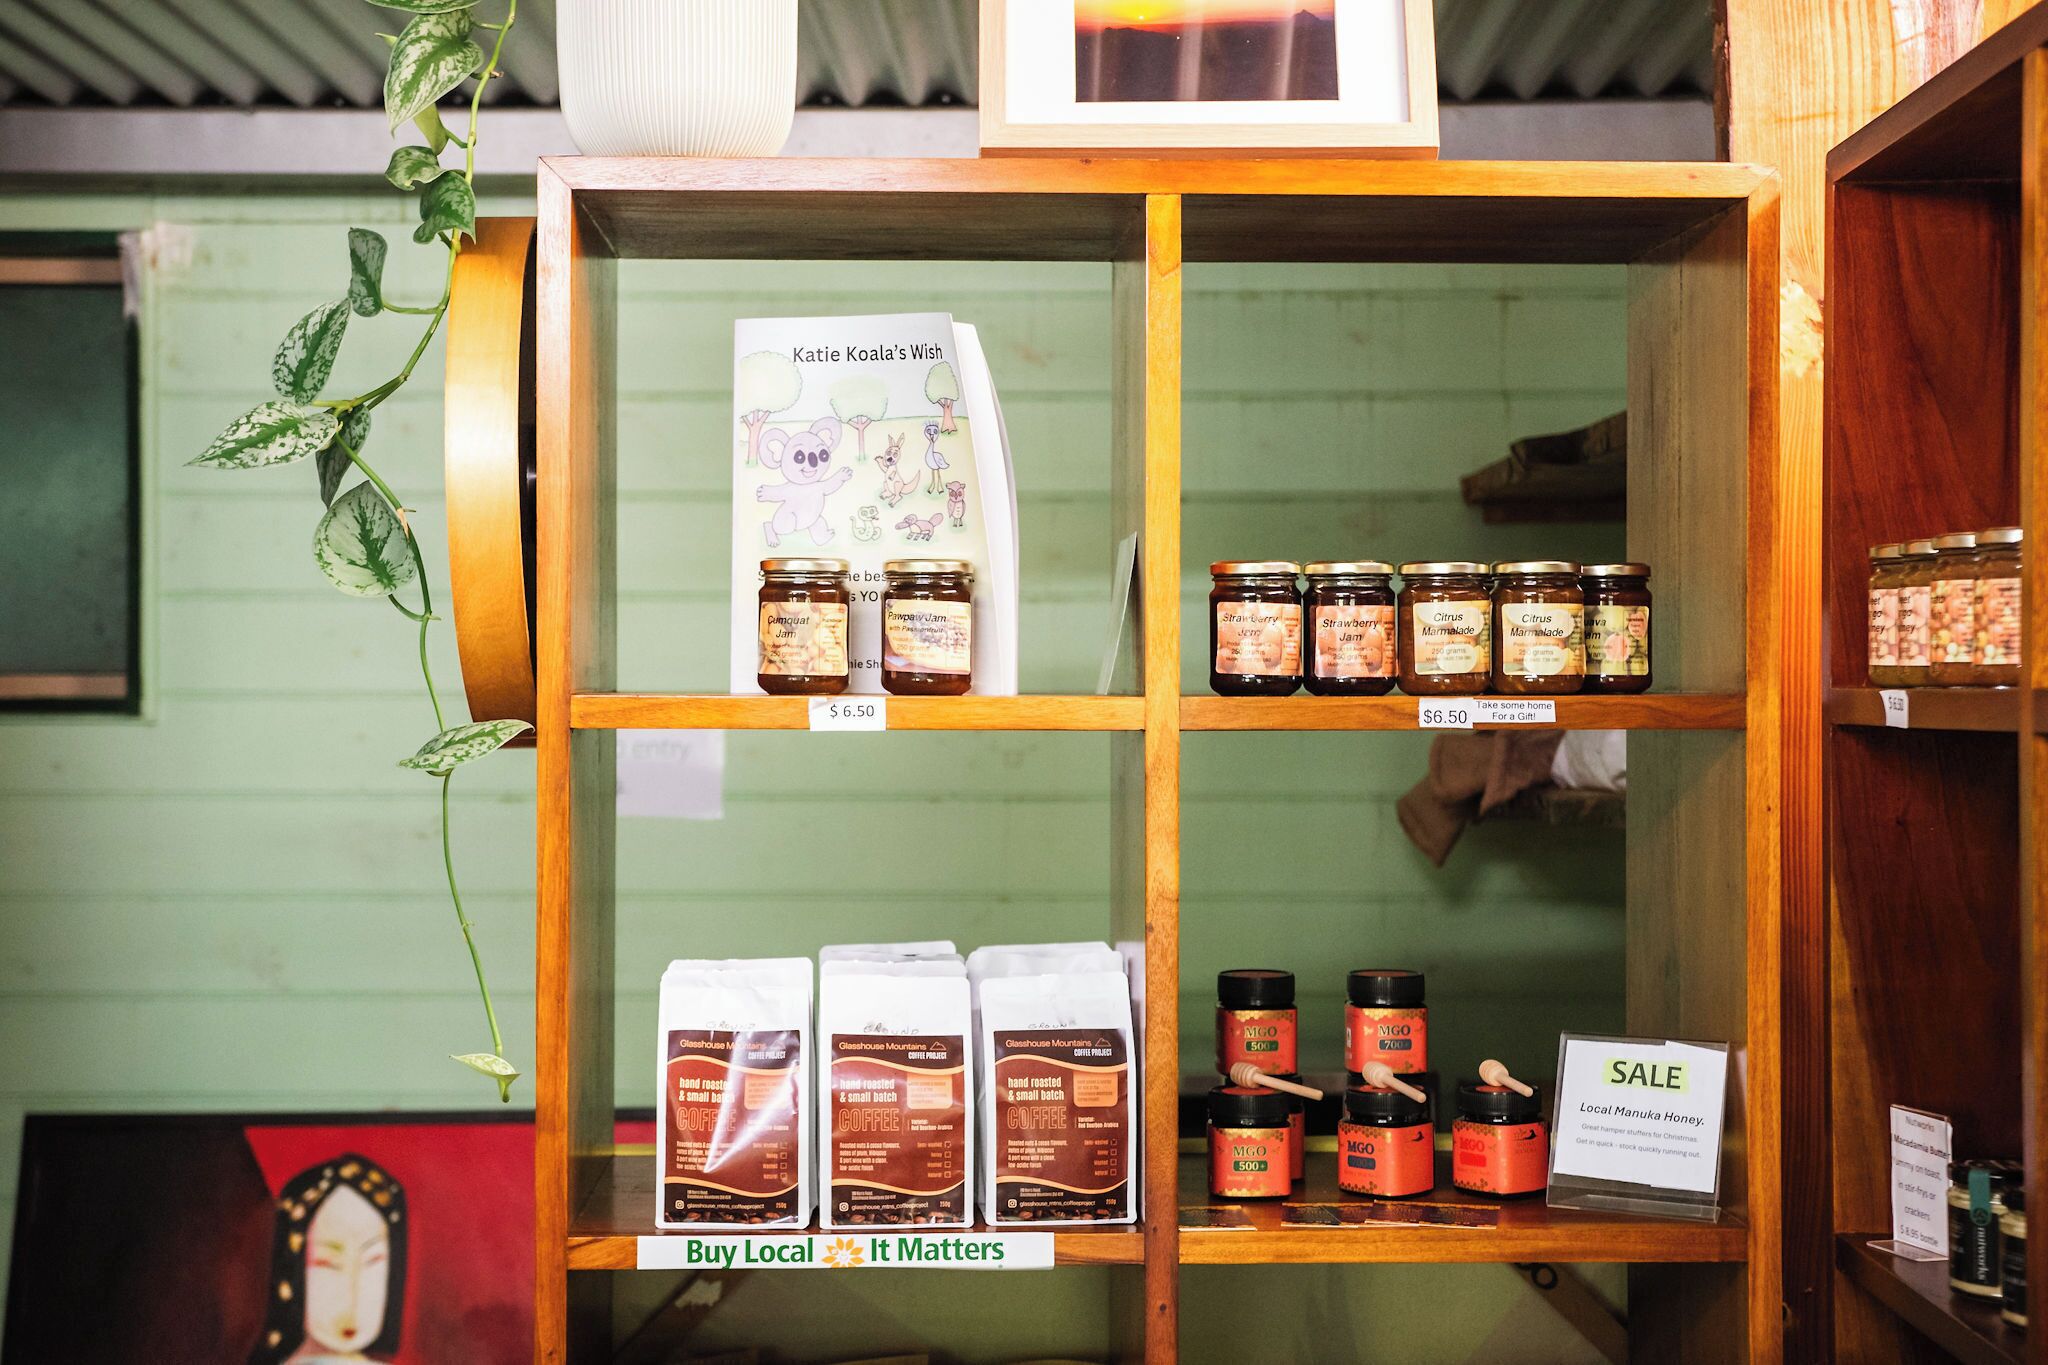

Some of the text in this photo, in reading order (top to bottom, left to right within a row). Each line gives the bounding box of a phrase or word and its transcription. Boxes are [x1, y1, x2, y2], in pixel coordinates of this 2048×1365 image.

[793, 343, 944, 363] Katie Koala's Wish
[865, 570, 886, 581] bes
[860, 591, 878, 602] YO
[768, 615, 810, 627] Cumquat
[888, 611, 947, 623] Pawpaw Jam
[1223, 613, 1278, 626] Strawberry
[1434, 612, 1463, 622] Citrus
[1522, 614, 1552, 623] Citrus
[1322, 618, 1379, 630] Strawberry
[776, 629, 797, 639] Jam
[1238, 629, 1262, 637] Jam
[1422, 626, 1475, 636] Marmalade
[1510, 627, 1564, 637] Marmalade
[1339, 633, 1362, 642] Jam
[830, 704, 875, 719] $ 6.50
[1476, 701, 1498, 709] Take
[1527, 701, 1552, 710] home
[1423, 709, 1468, 724] $6.50
[1492, 712, 1507, 720] For
[1517, 712, 1536, 721] Gift!
[1244, 1026, 1277, 1038] MGO
[1378, 1025, 1411, 1036] MGO
[680, 1039, 726, 1050] Glasshouse
[839, 1041, 927, 1051] Glasshouse Mountains
[1005, 1039, 1092, 1048] Glasshouse Mountains
[748, 1050, 786, 1060] COFFEE PROJECT
[908, 1051, 947, 1060] COFFEE PROJECT
[1074, 1048, 1112, 1057] COFFEE PROJECT
[1610, 1060, 1682, 1090] SALE
[680, 1077, 728, 1091] hand roaste
[840, 1078, 895, 1090] hand roasted
[1008, 1076, 1062, 1089] hand roasted
[679, 1090, 686, 1102] &
[687, 1091, 709, 1102] small
[840, 1092, 846, 1103] &
[848, 1091, 871, 1103] small
[873, 1091, 897, 1103] batch
[1008, 1090, 1015, 1102] &
[1016, 1090, 1039, 1101] small
[1041, 1089, 1064, 1101] batch
[676, 1107, 737, 1132] COFFE
[839, 1108, 900, 1132] COFFEE
[1007, 1105, 1067, 1129] COFFEE
[1580, 1102, 1705, 1127] Local Manuka Honey.
[1581, 1123, 1599, 1131] Great
[1600, 1125, 1625, 1136] hamper
[1627, 1128, 1652, 1138] stuffers
[1653, 1131, 1662, 1139] for
[1233, 1145, 1267, 1157] MGO
[1347, 1140, 1375, 1155] MGO
[1576, 1137, 1587, 1145] Get
[1596, 1139, 1613, 1148] quick
[1619, 1142, 1636, 1150] stock
[1637, 1145, 1661, 1155] quickly
[1662, 1148, 1687, 1158] running
[1894, 1134, 1951, 1160] Macadamia Butter
[1239, 1161, 1265, 1171] 500+
[1904, 1206, 1930, 1221] crackers
[687, 1237, 1004, 1269] Buy Local It Matters
